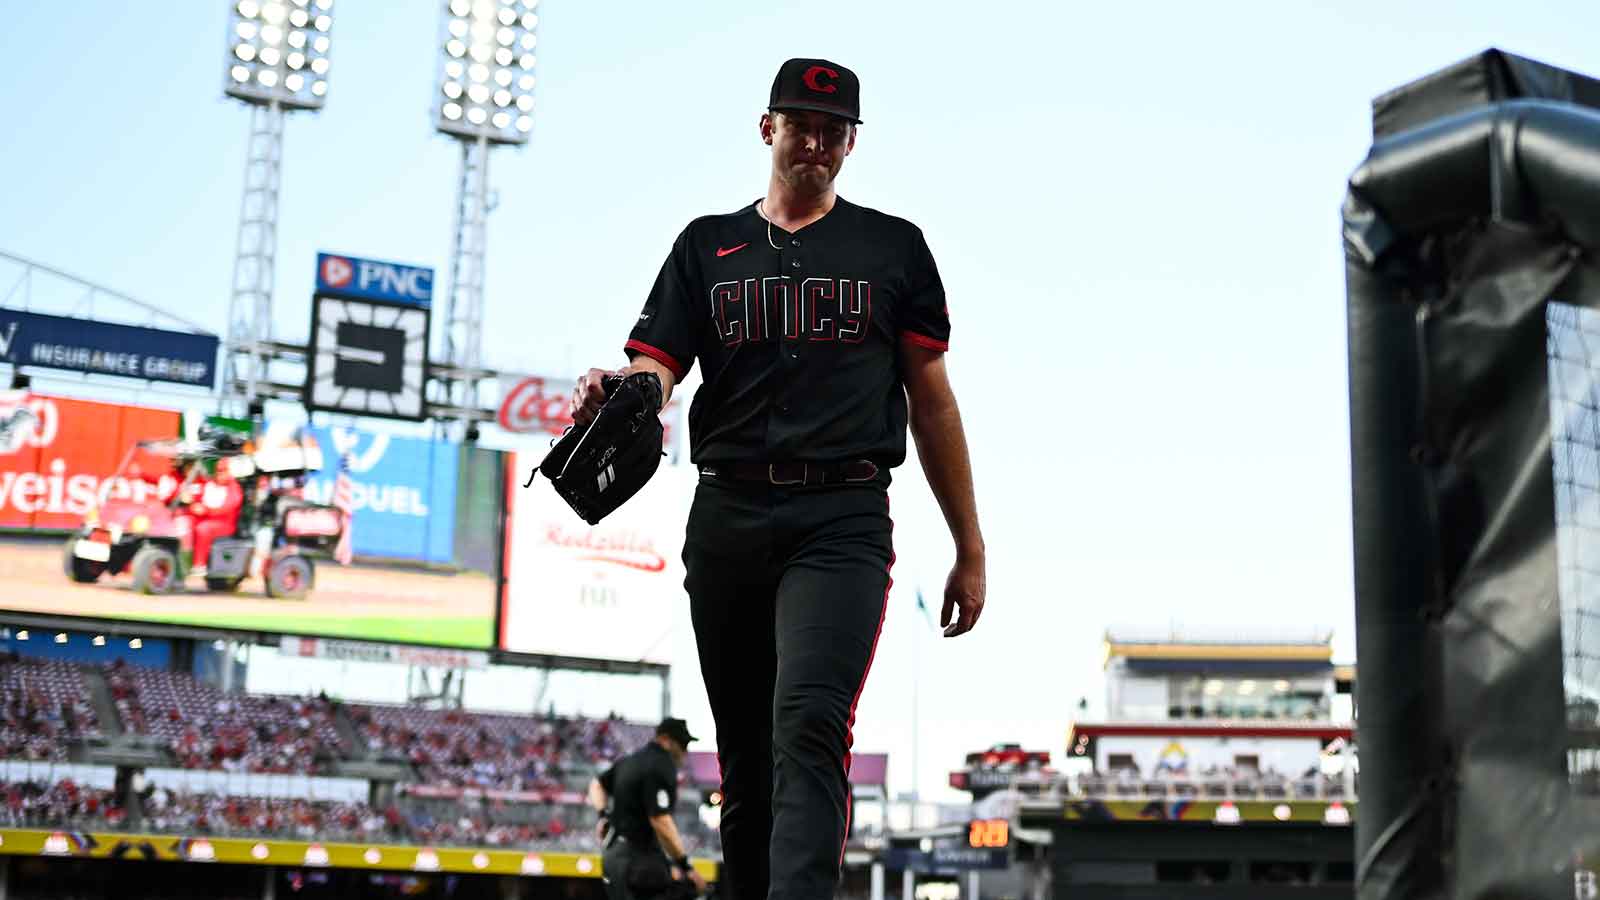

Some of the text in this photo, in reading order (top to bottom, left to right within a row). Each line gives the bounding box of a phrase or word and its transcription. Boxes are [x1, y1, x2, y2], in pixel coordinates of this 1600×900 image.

[802, 65, 840, 94] C
[359, 261, 432, 299] PNC
[31, 342, 207, 384] INSURANCE GROUP
